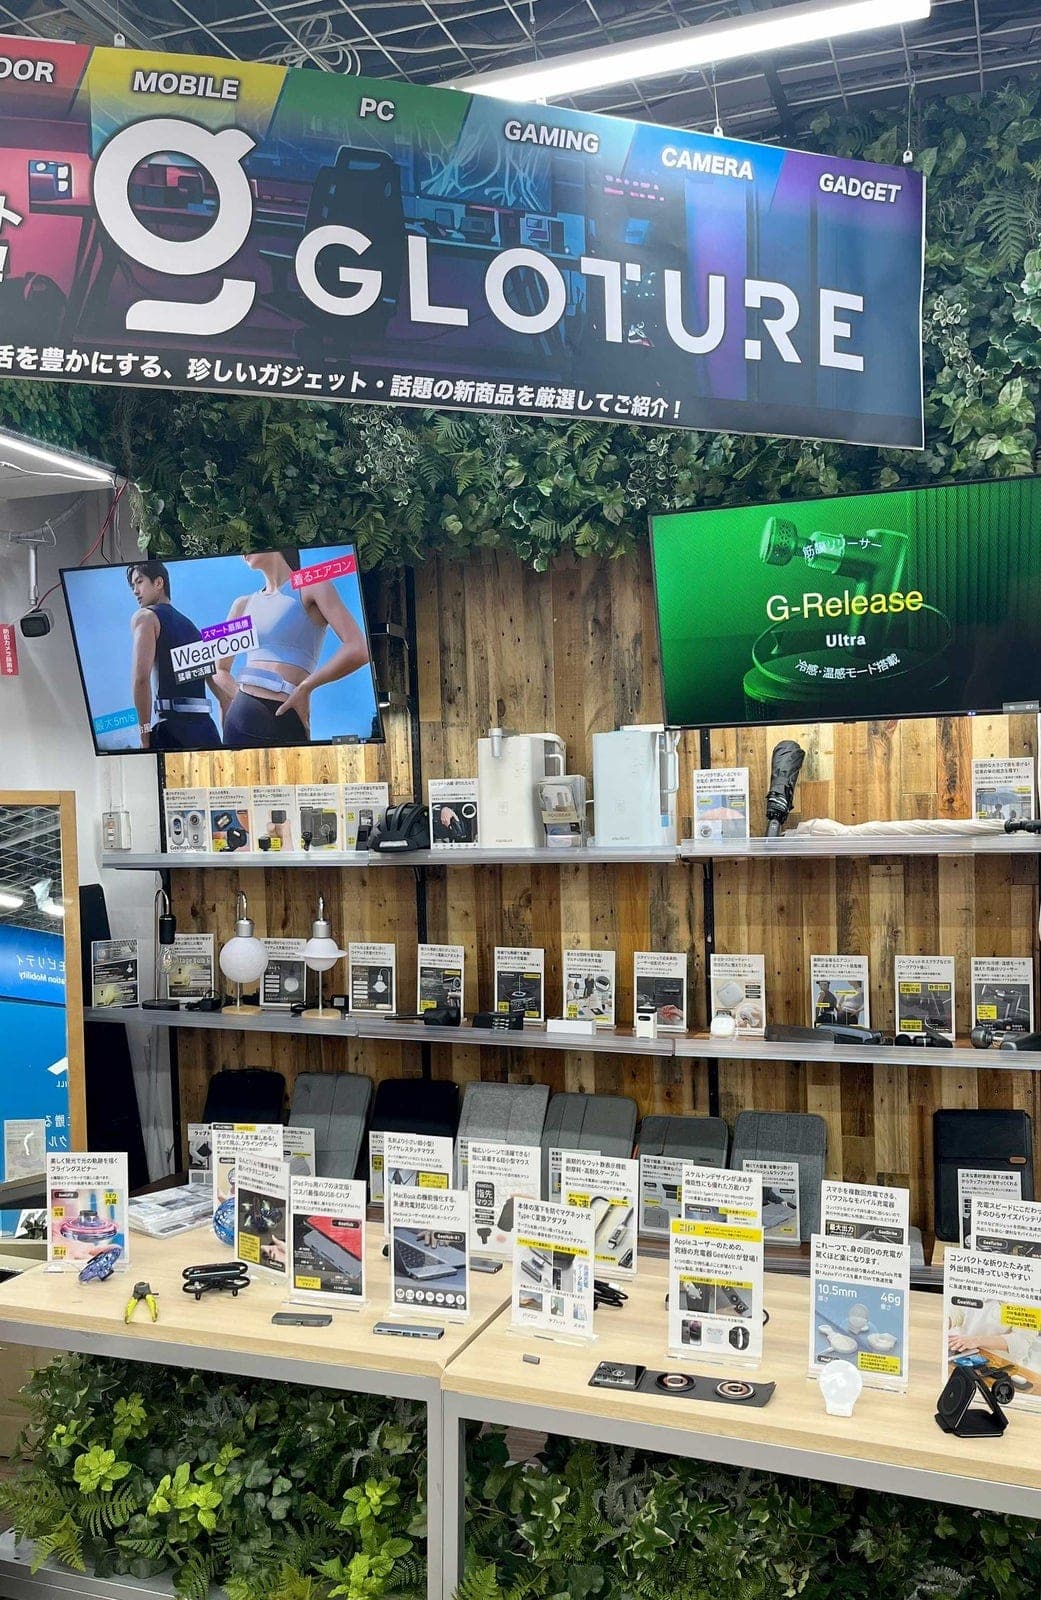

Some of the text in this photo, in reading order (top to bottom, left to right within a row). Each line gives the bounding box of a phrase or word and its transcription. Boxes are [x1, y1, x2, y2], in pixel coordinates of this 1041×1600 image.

[133, 71, 239, 100] MOBILE
[360, 97, 396, 122] PC
[504, 120, 599, 153] GAMING
[661, 147, 753, 180] CAMERA
[819, 173, 901, 203] GADGET
[295, 224, 864, 372] GLOTURE
[292, 560, 353, 588] 着るエアコン
[766, 589, 924, 622] G-Release
[173, 630, 255, 667] WearCool
[825, 633, 866, 648] Ultra
[476, 1198, 493, 1206] マウス
[826, 1194, 895, 1209] パワフルなモバイル充電器
[815, 1241, 904, 1259] これ一つで、身の回りの充電が
[815, 1250, 880, 1266] 驚くほど楽になります。
[949, 1254, 1034, 1273] コンパクトな折りたたみ式、
[949, 1263, 1031, 1281] 外出時に持っていきやすい
[817, 1283, 858, 1299] 10.5mm
[880, 1291, 901, 1306] 46g
